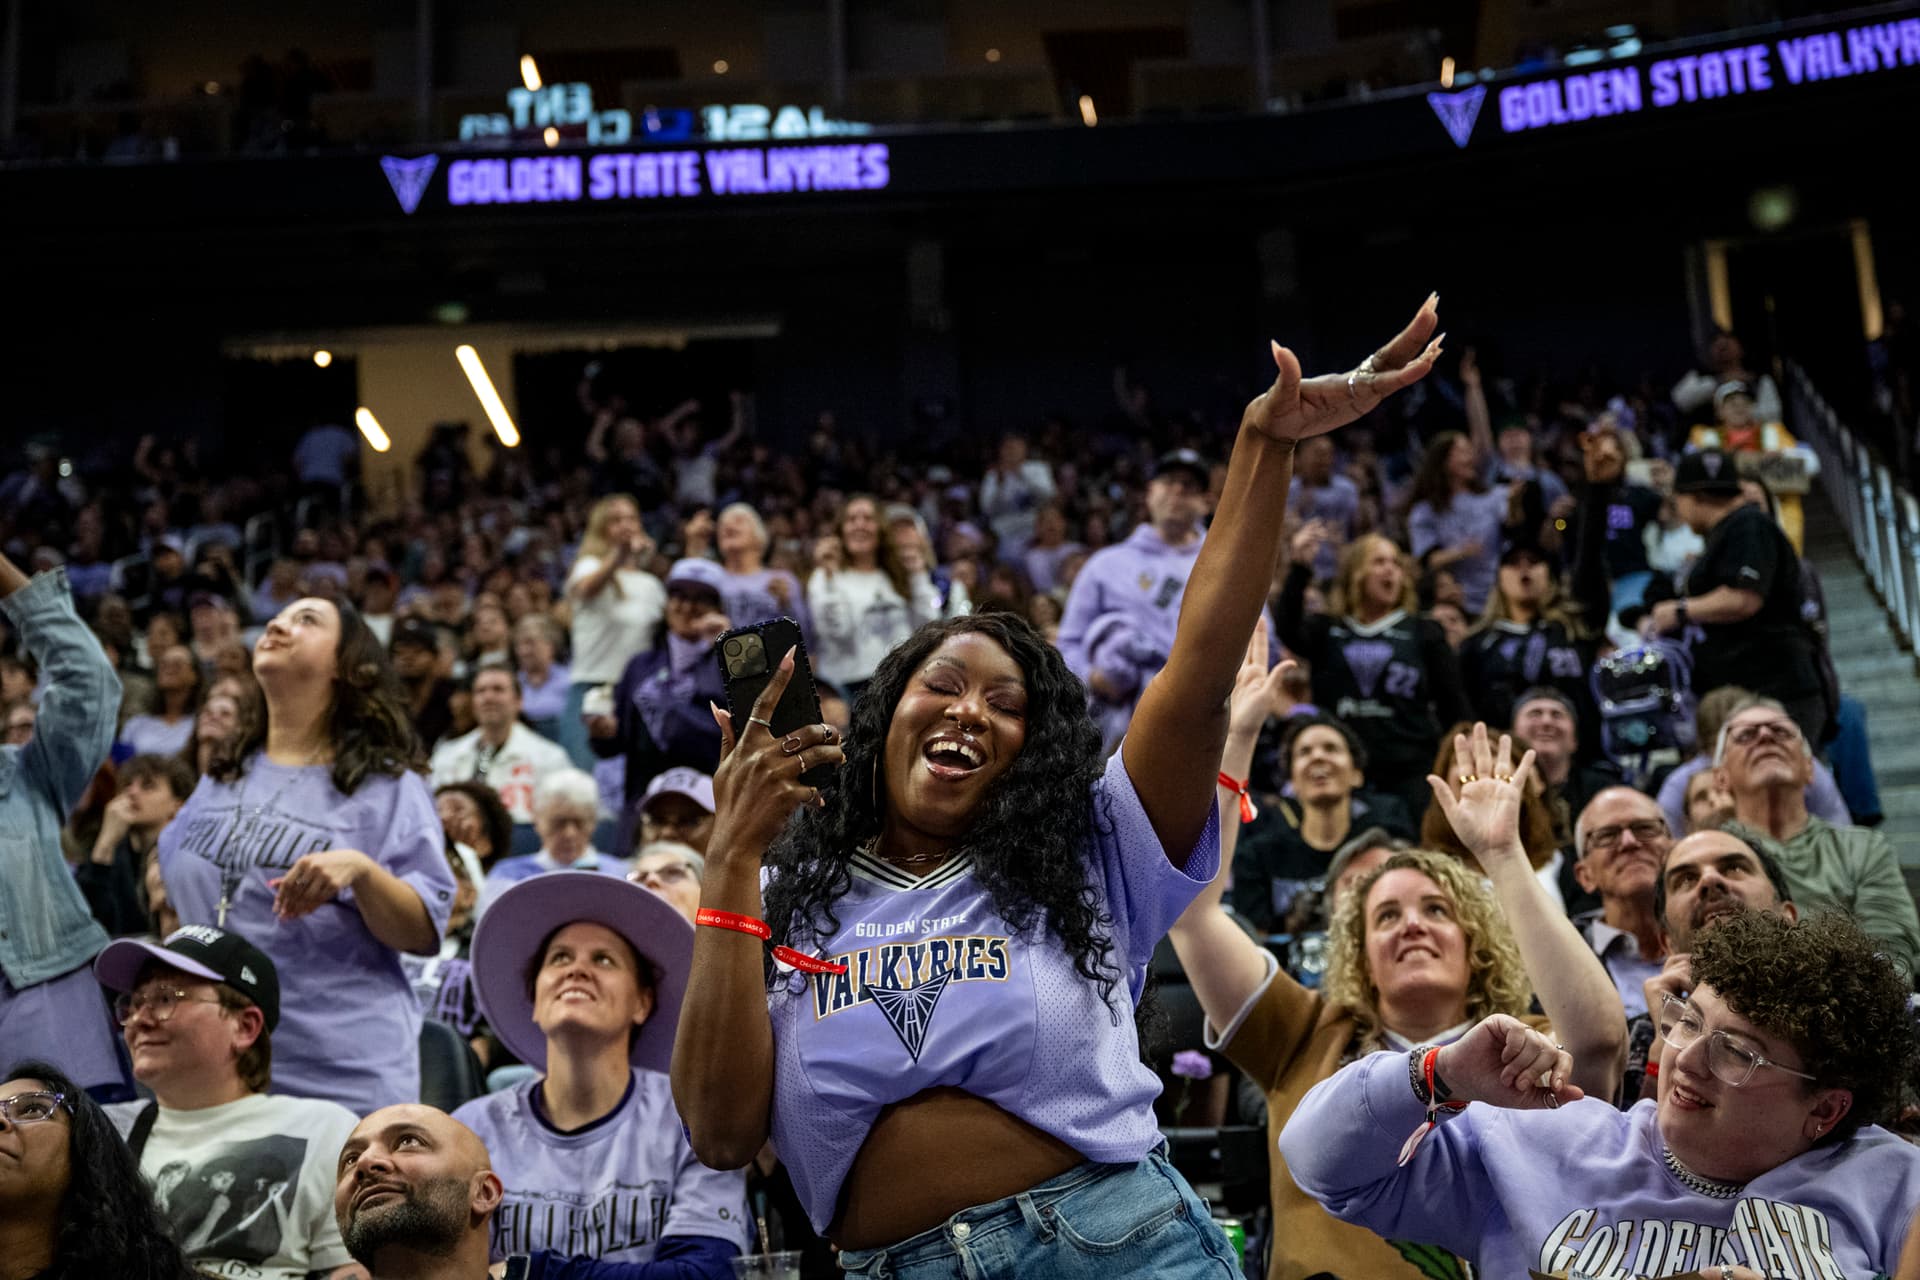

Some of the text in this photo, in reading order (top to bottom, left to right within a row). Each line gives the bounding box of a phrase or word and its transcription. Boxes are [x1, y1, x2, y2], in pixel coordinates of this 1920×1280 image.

[1500, 66, 1642, 133] GOLDEN
[1649, 45, 1771, 107] STATE
[448, 143, 889, 206] GOLDEN STATE VALKYRIES
[856, 914, 967, 937] GOLDEN STATE
[812, 936, 1011, 1020] VALKYRIES
[1540, 1207, 1732, 1280] GOLDEN
